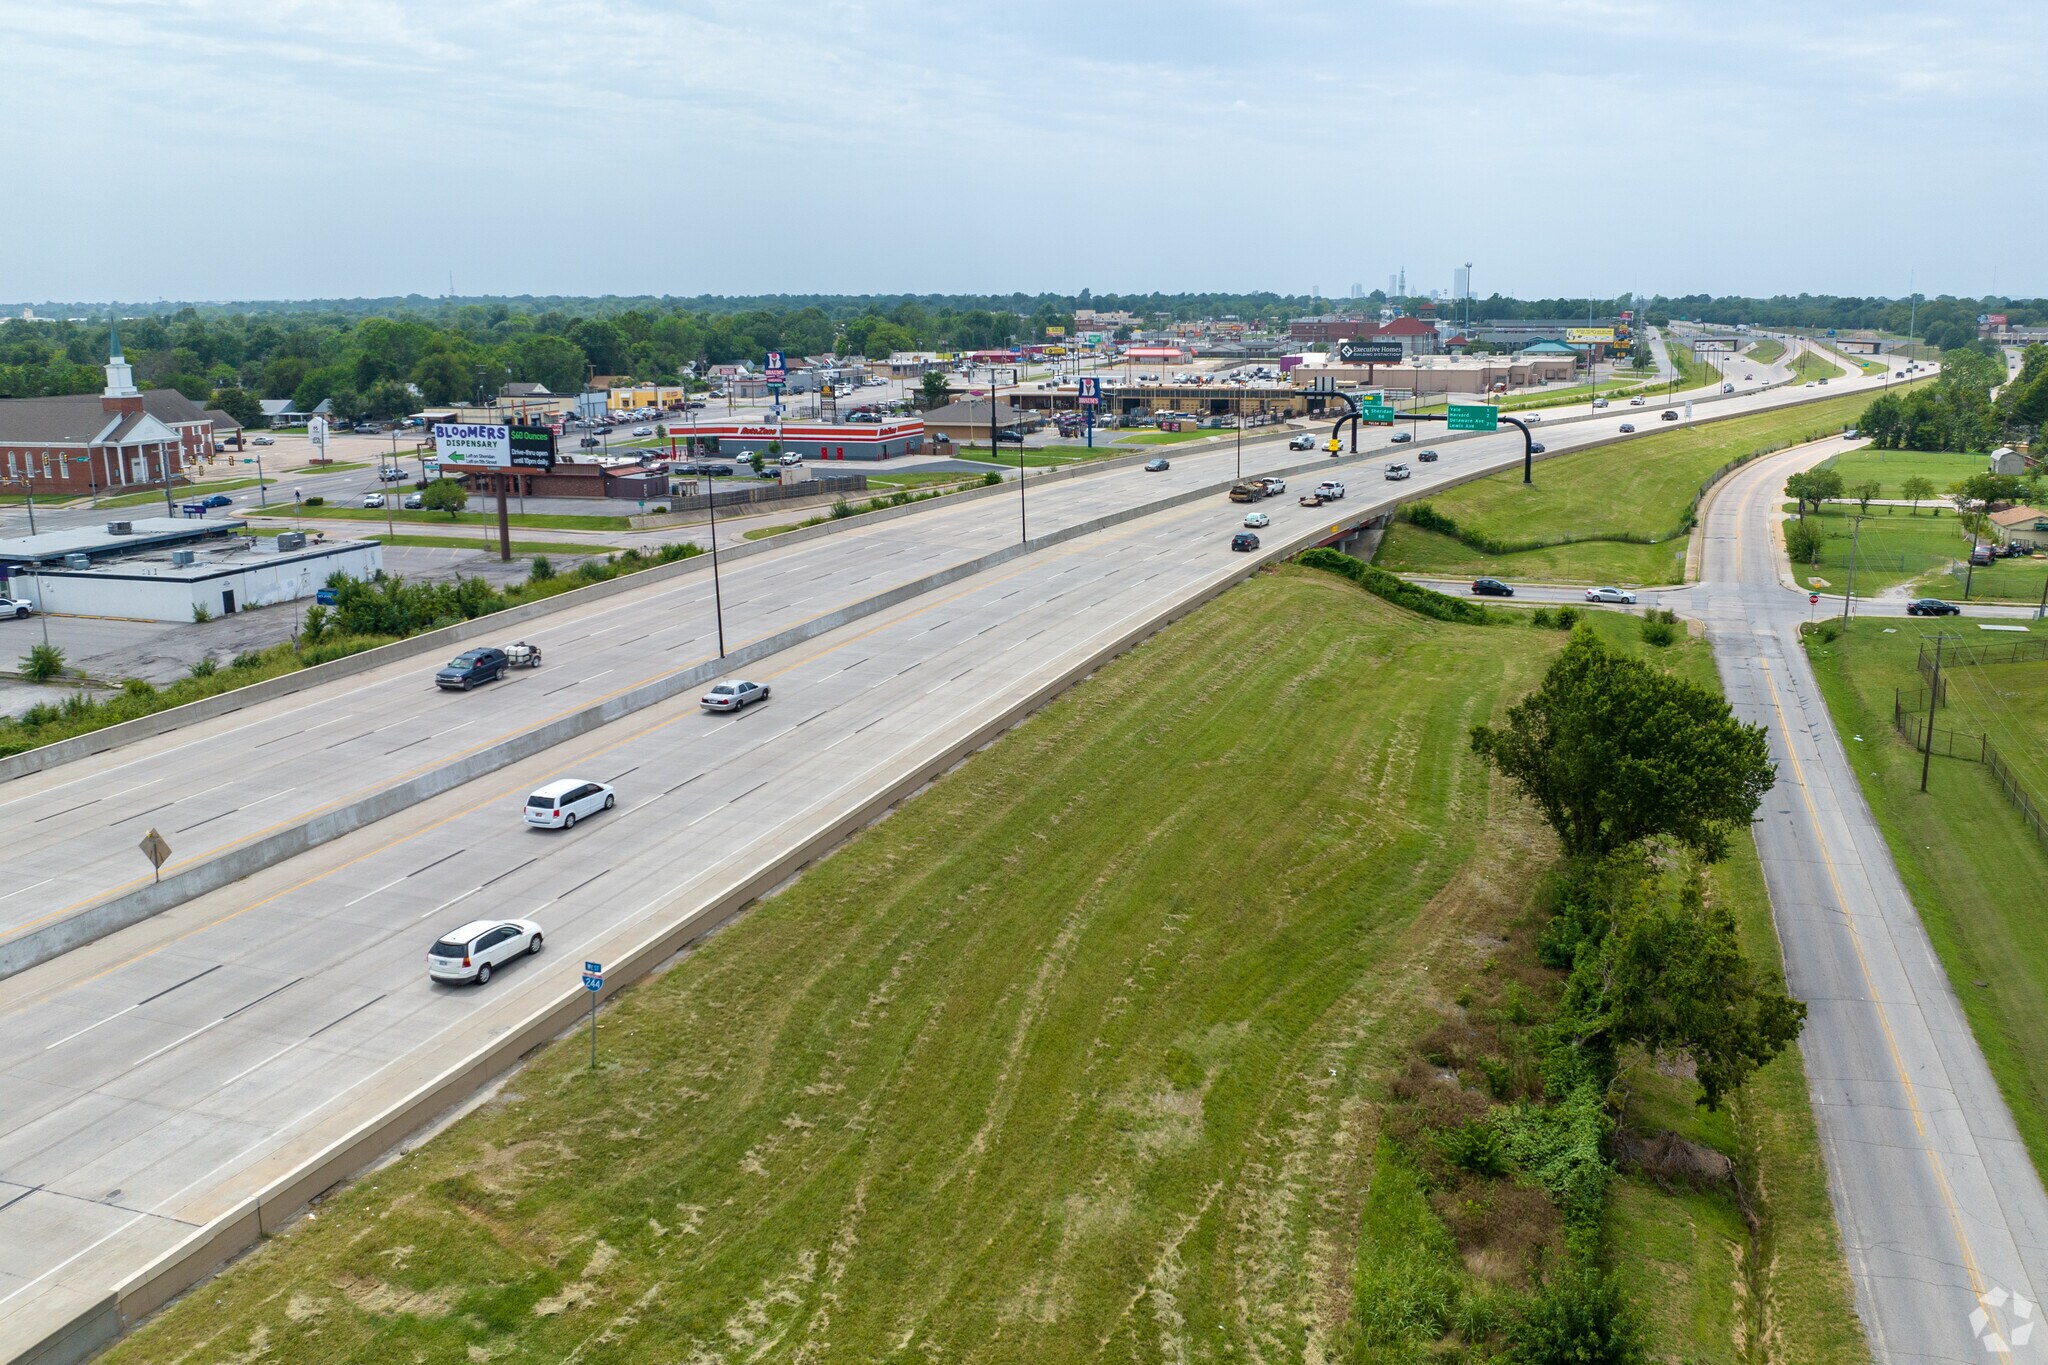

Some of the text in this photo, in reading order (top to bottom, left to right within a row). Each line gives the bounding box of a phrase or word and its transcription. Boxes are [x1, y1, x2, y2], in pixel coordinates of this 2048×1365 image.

[436, 426, 505, 439] BLOOMERS
[740, 426, 777, 435] AutoZone
[523, 432, 548, 440] Ounces
[587, 963, 599, 971] WEST
[585, 978, 600, 988] 244
